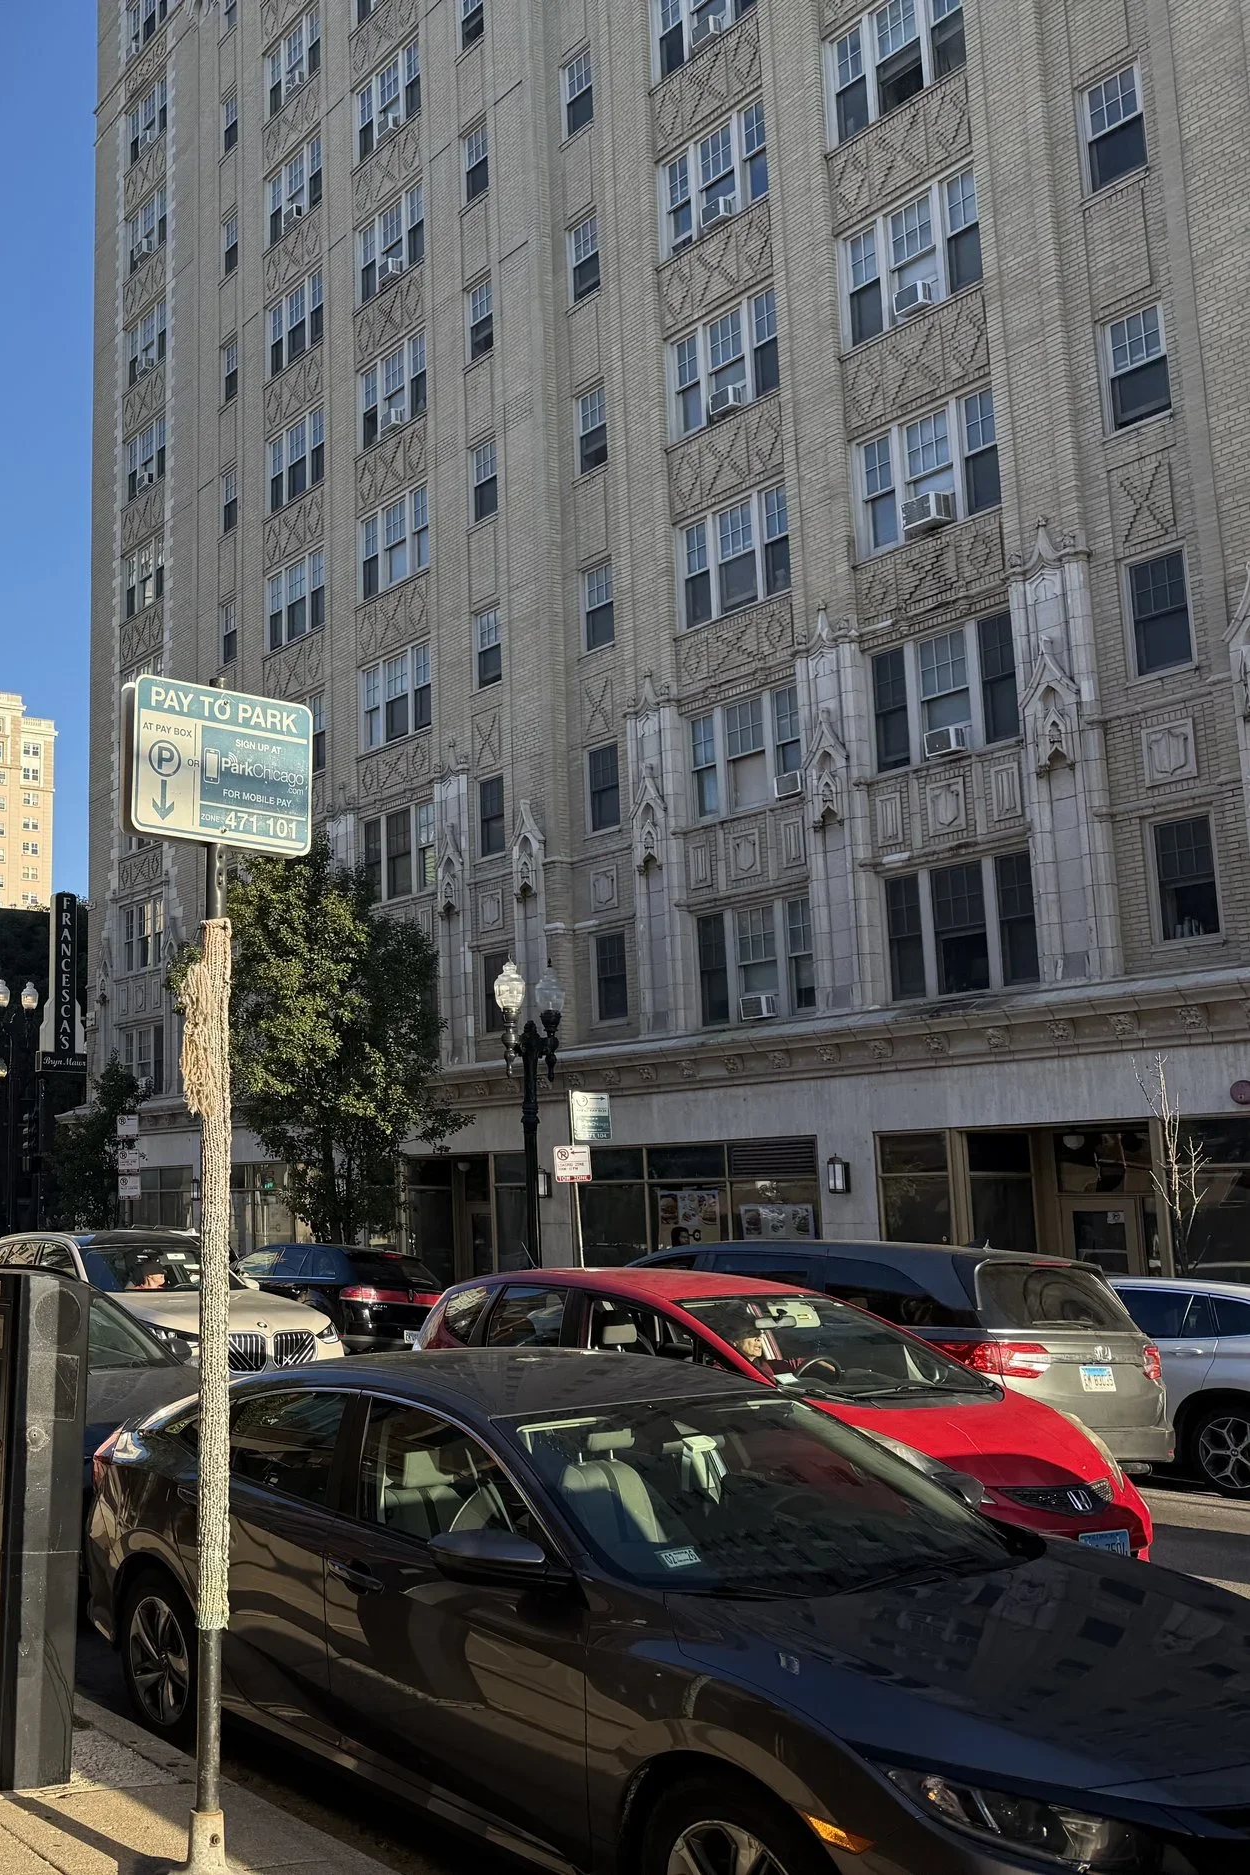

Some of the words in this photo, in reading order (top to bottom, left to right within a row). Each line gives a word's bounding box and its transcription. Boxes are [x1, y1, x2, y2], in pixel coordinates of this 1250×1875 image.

[151, 686, 194, 713] PAY
[200, 695, 231, 720] TO
[238, 703, 298, 733] PARK
[143, 721, 153, 731] AT
[155, 725, 172, 735] PAY
[174, 727, 192, 738] BOX
[235, 738, 256, 750] SIGN
[257, 743, 269, 752] UP
[270, 746, 282, 755] AT
[187, 758, 200, 768] OR
[221, 756, 304, 787] ParkChicago
[222, 788, 241, 799] FOR
[242, 792, 275, 805] MOBILE
[276, 797, 292, 808] PAY
[287, 787, 304, 796] .com
[225, 811, 257, 833] 471
[267, 817, 297, 839] 101
[60, 897, 72, 1050] FRANCESCA'S
[43, 1056, 63, 1068] Bryn
